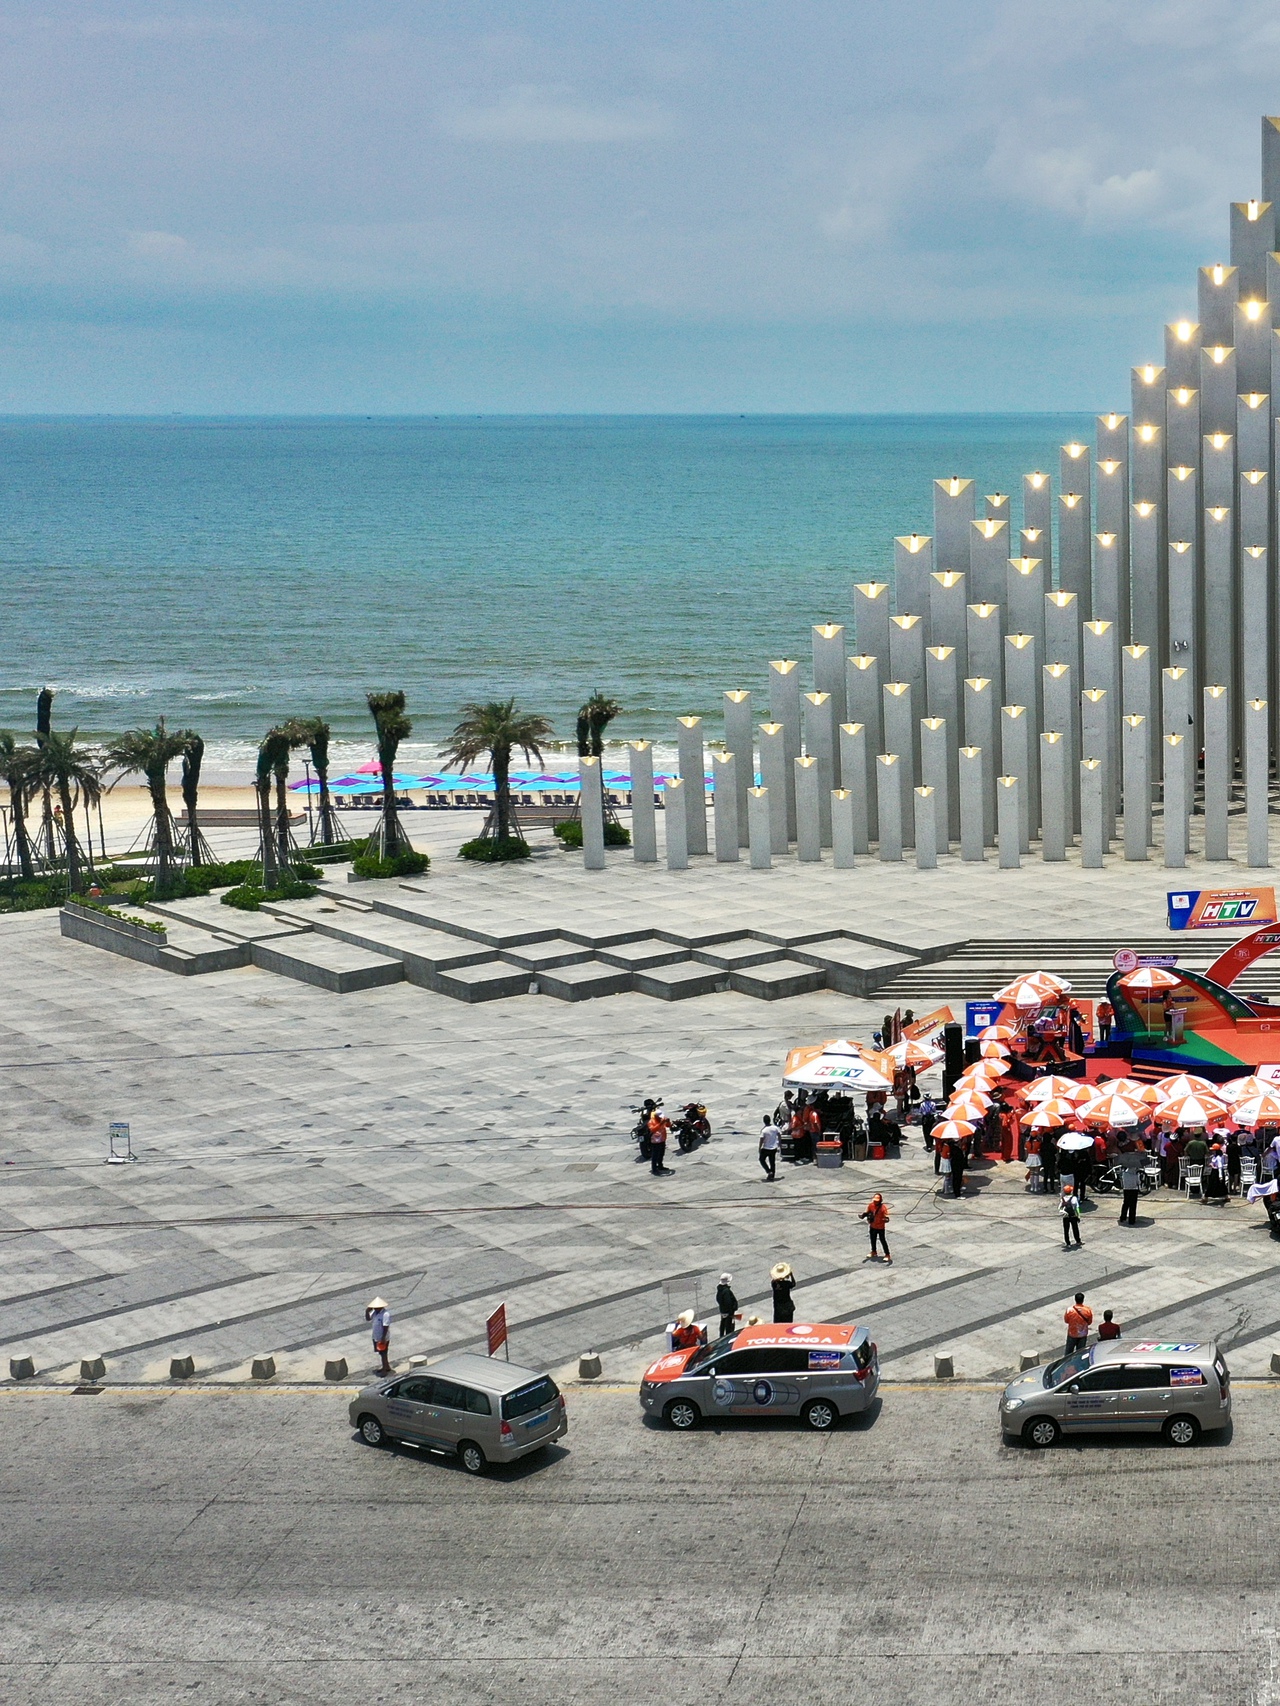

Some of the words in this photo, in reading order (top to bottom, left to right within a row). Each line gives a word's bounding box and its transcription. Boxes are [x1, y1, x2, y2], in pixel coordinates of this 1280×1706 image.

[1201, 901, 1257, 919] HTV
[816, 1067, 863, 1077] HTV
[746, 1337, 776, 1345] TON
[1131, 1343, 1199, 1352] HTV
